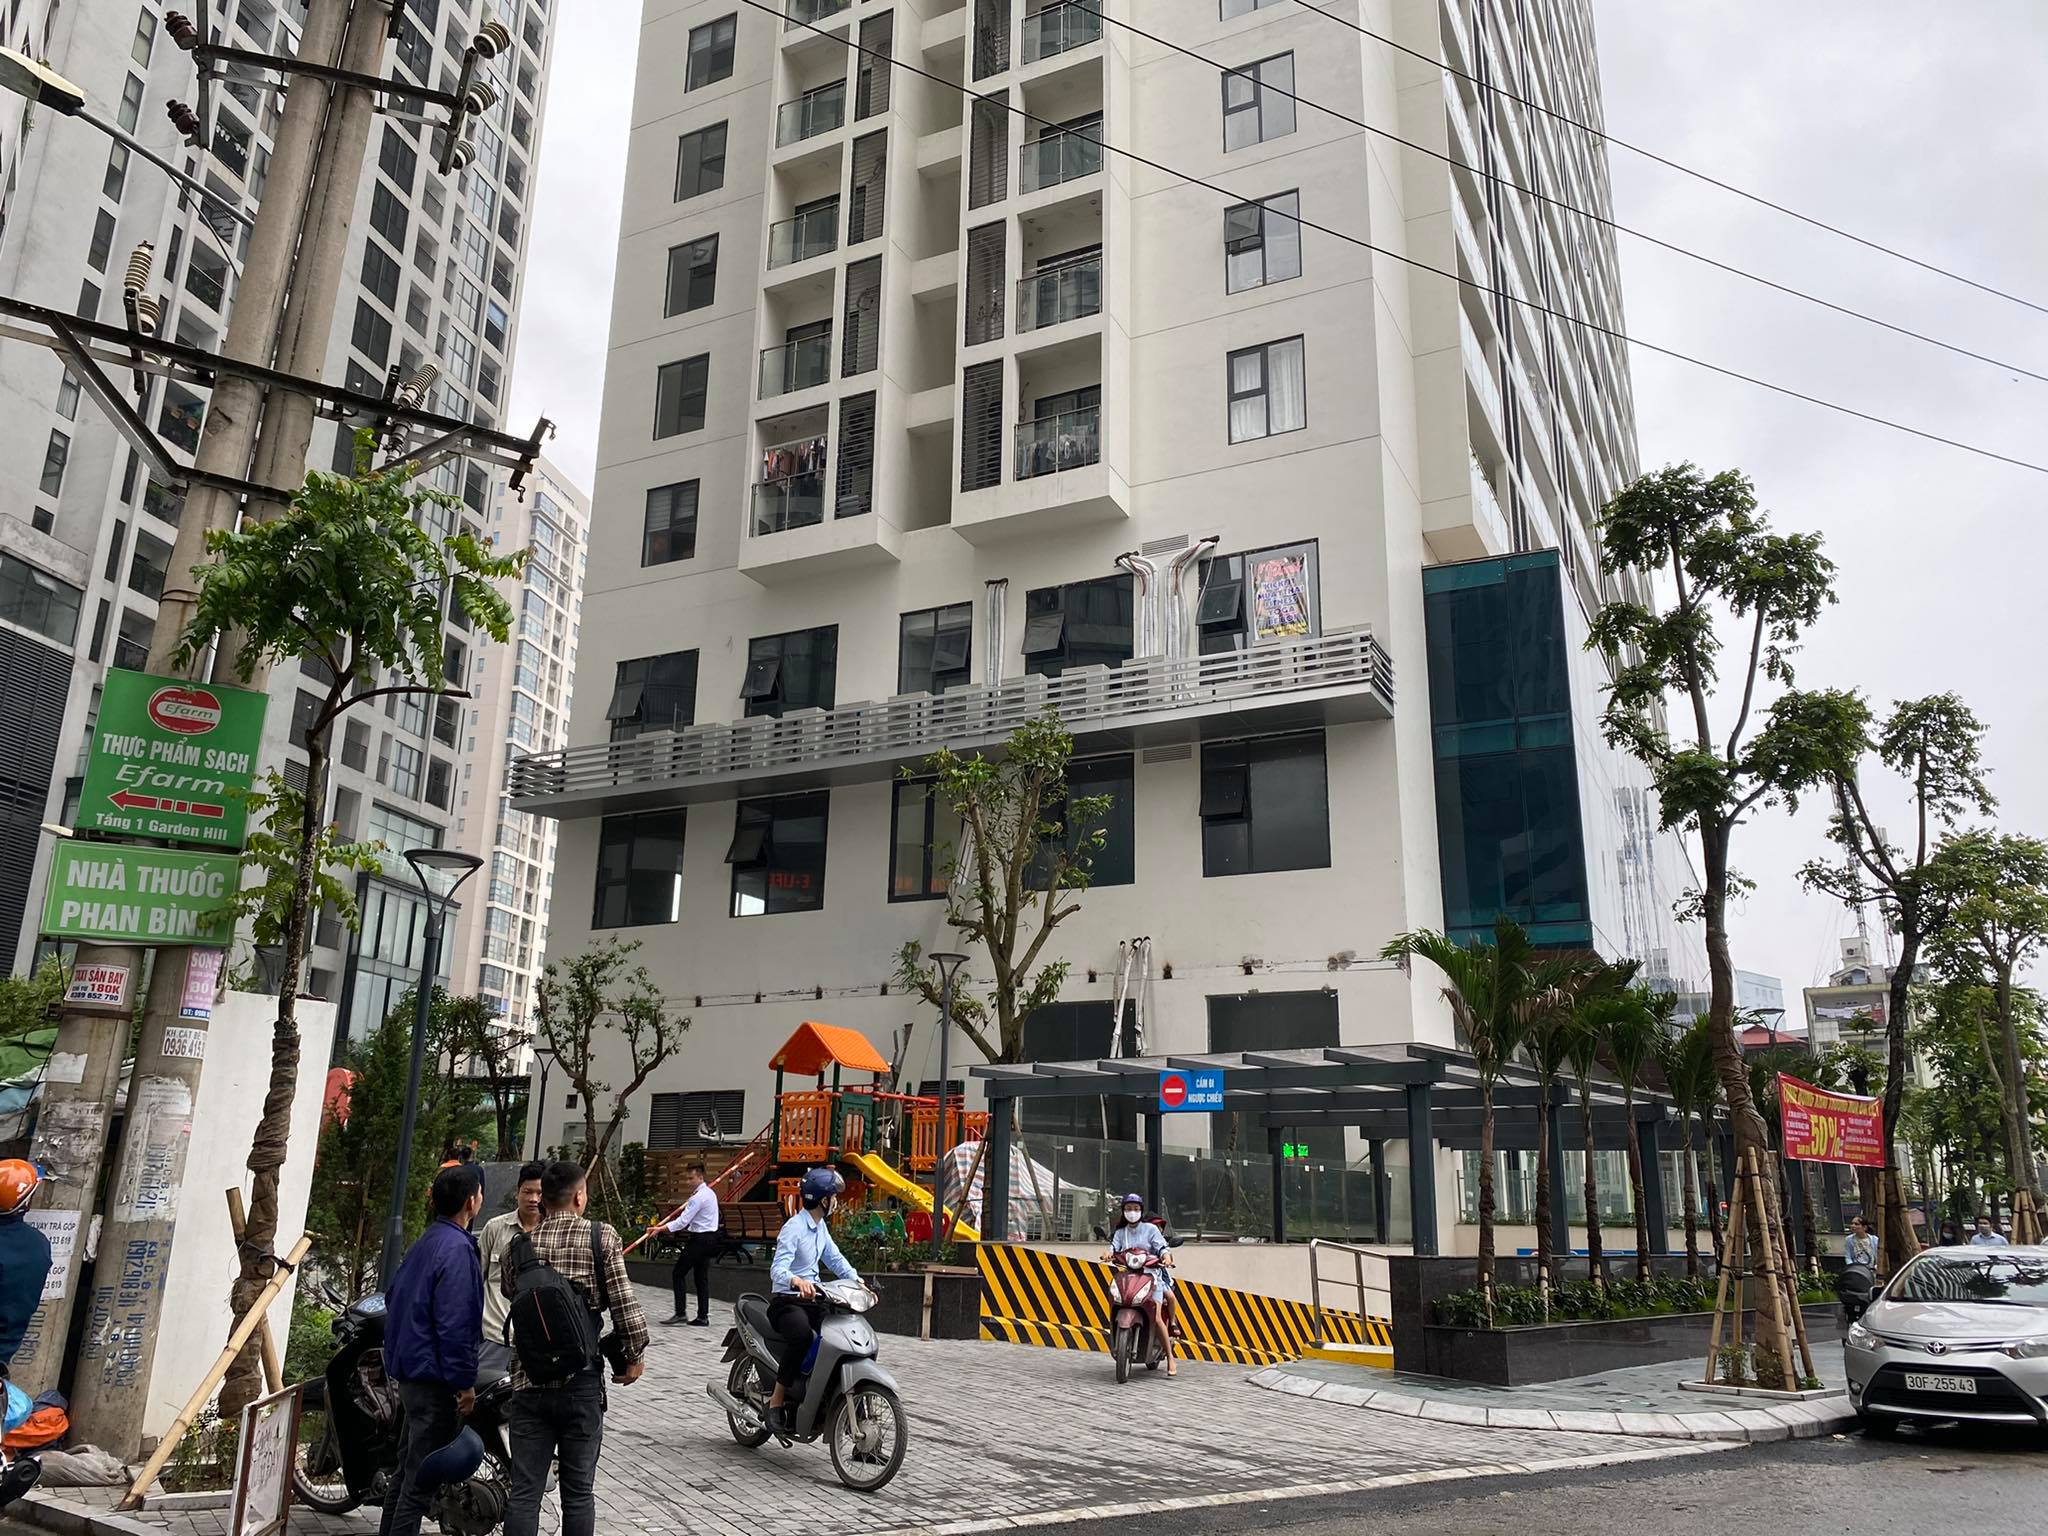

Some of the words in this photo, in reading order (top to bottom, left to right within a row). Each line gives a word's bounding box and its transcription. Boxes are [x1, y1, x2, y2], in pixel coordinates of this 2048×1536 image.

[1269, 605, 1296, 616] YOGA
[164, 703, 213, 719] Efarm
[102, 733, 147, 761] THỰC
[149, 737, 201, 767] PHẨM
[204, 749, 250, 774] SẠCH
[115, 764, 226, 795] Efarm
[136, 818, 144, 830] 1
[148, 819, 200, 838] Garden
[203, 827, 228, 841] Hill
[66, 857, 126, 891] NHÀ
[137, 862, 225, 898] THUỐC
[59, 900, 141, 933] PHAN
[108, 971, 124, 985] BAY
[90, 984, 120, 994] 180K
[1195, 1076, 1208, 1088] CẤM
[1188, 1093, 1206, 1105] NGƯỢC
[1206, 1090, 1223, 1103] CHIỀU
[1810, 1113, 1841, 1158] 50%
[1907, 1375, 1974, 1392] 30F-255.43
